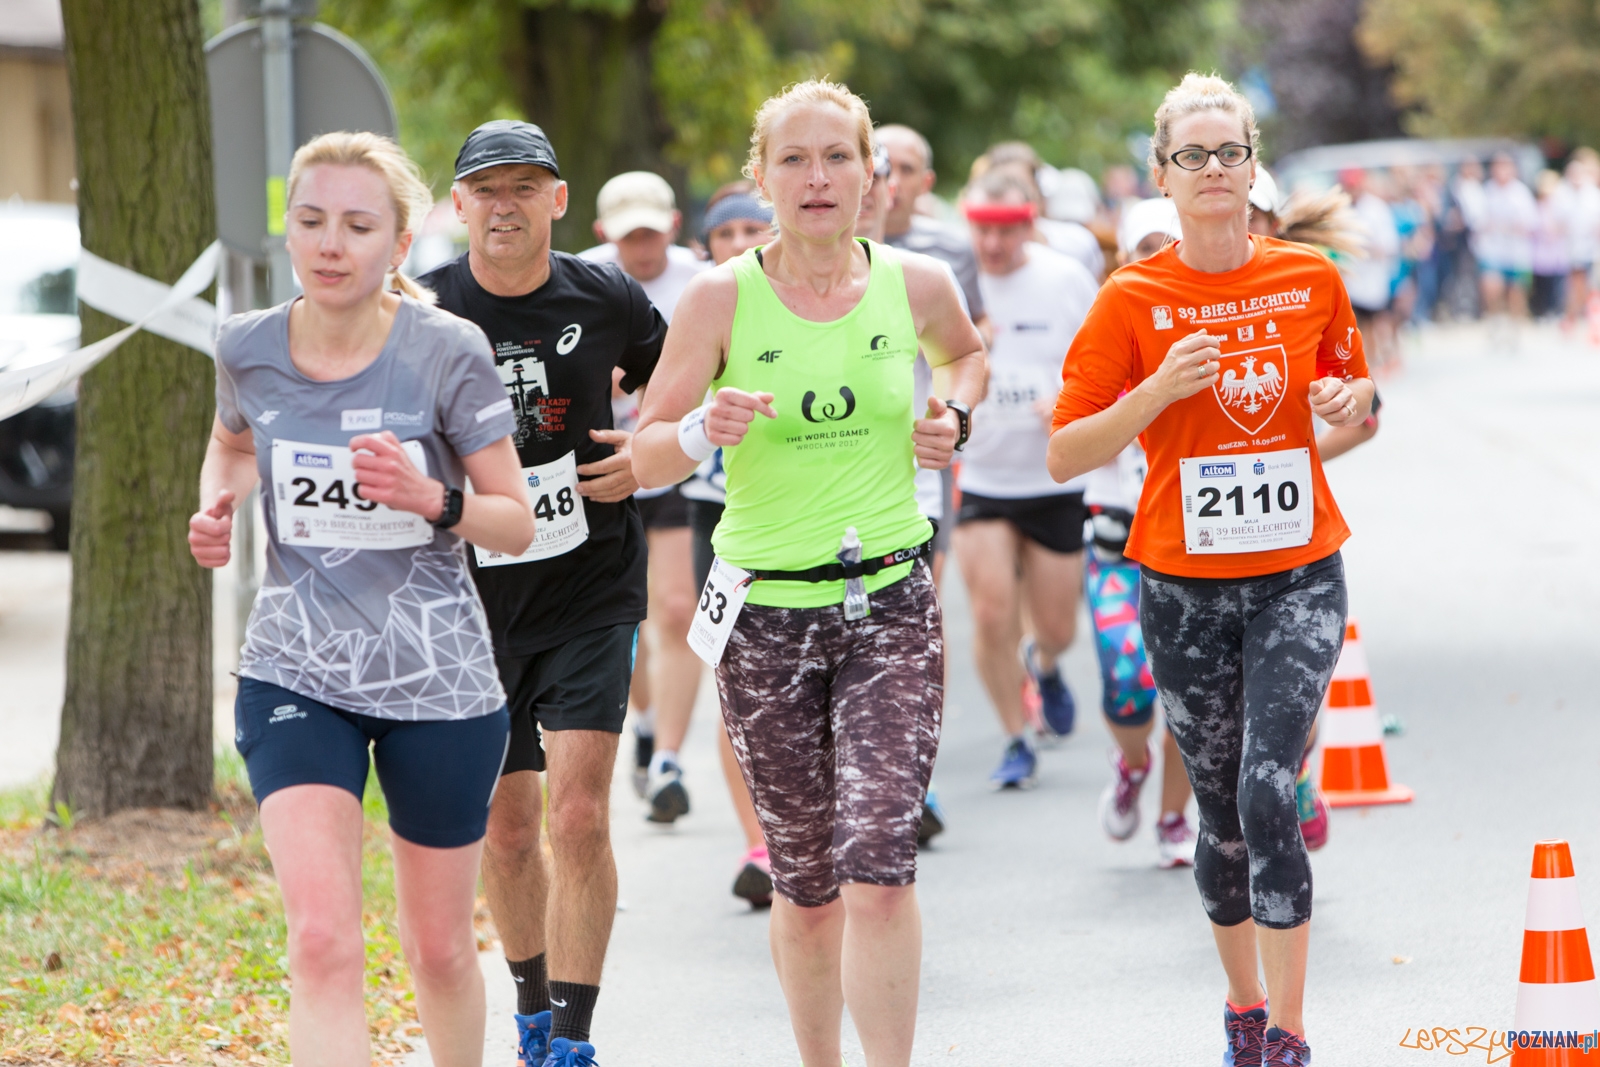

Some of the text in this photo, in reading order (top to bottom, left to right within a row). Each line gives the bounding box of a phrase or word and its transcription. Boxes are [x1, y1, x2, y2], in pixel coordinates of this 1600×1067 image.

[1177, 287, 1312, 320] 39 BIEG LECHITÓW
[757, 350, 783, 363] 4F
[785, 428, 869, 443] THE WORLD GAMES
[838, 439, 859, 448] 2017
[1251, 434, 1286, 446] 18.09.2016
[534, 486, 574, 522] 48
[1197, 480, 1299, 518] 2110
[313, 518, 415, 531] 39 BIEG LECHITÓW
[541, 518, 579, 541] LECHITÓW
[1216, 519, 1302, 536] 39 BIEG LECHITÓW
[700, 580, 727, 625] 53
